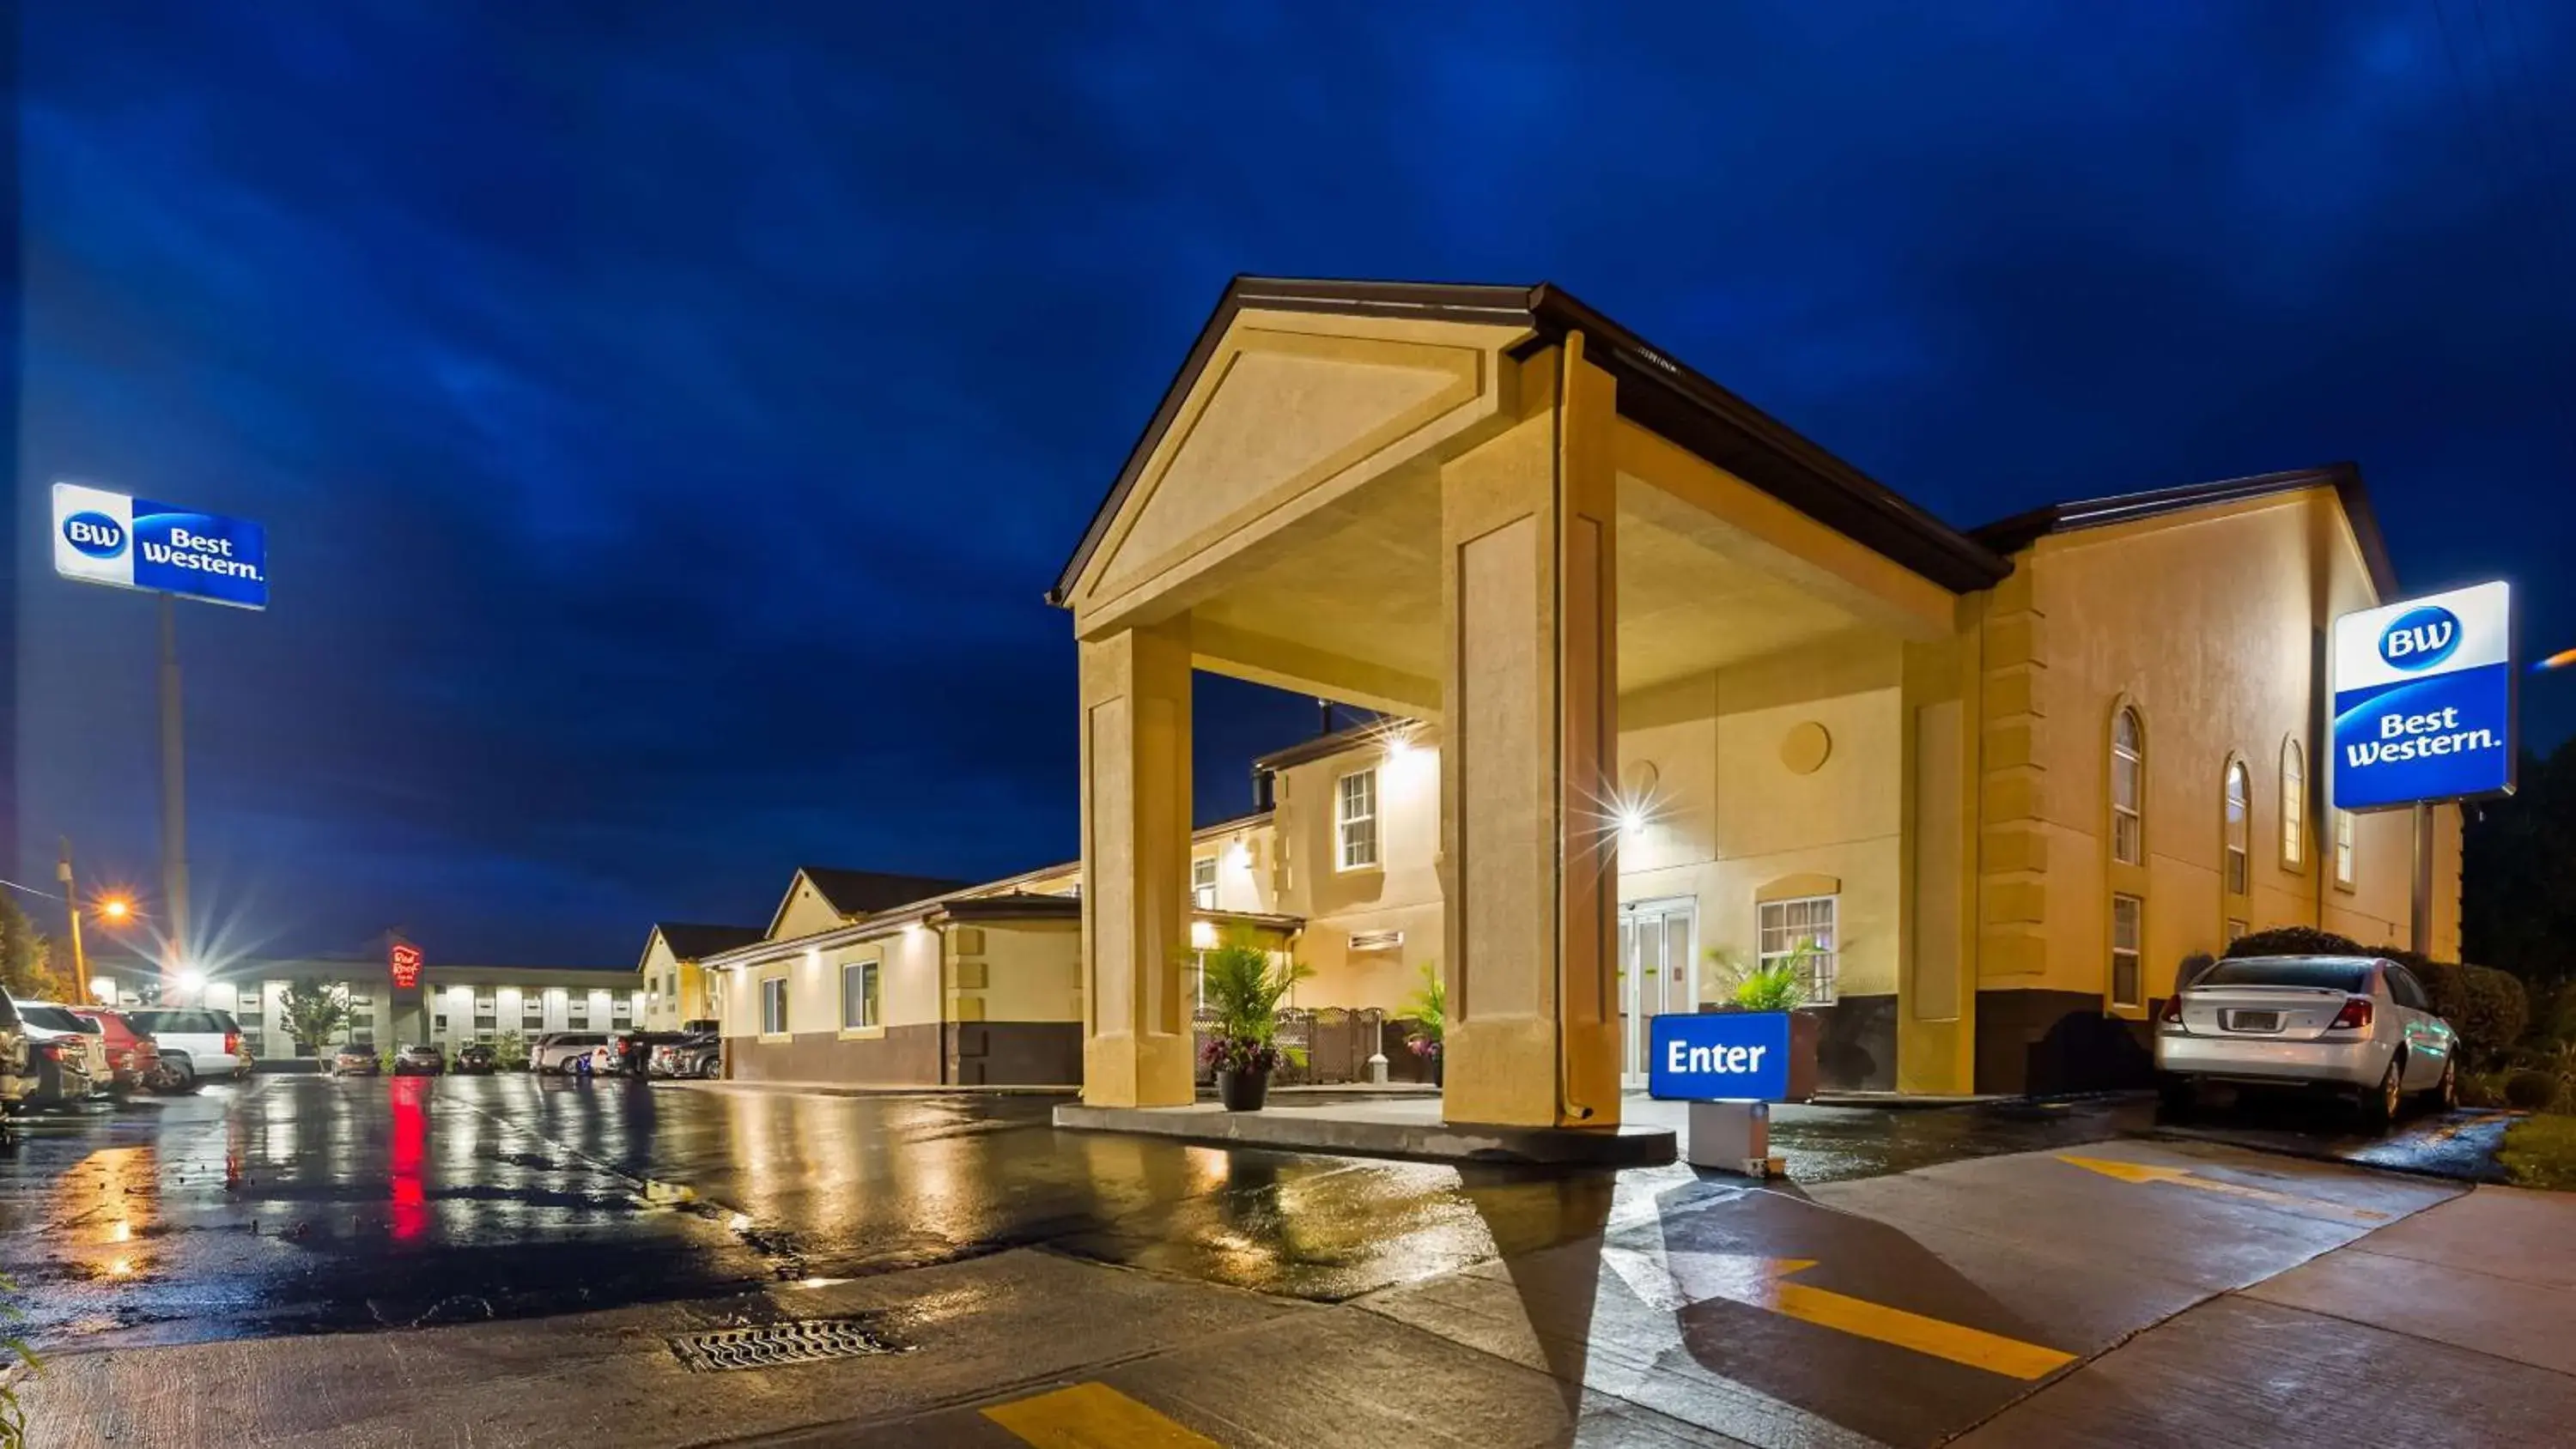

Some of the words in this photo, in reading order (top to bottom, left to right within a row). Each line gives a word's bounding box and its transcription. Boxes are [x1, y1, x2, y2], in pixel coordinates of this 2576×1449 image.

[70, 521, 119, 547] BW
[171, 528, 233, 556] Best
[2388, 621, 2453, 658] BW
[2381, 706, 2458, 738] Best
[1668, 1040, 1766, 1073] Enter
